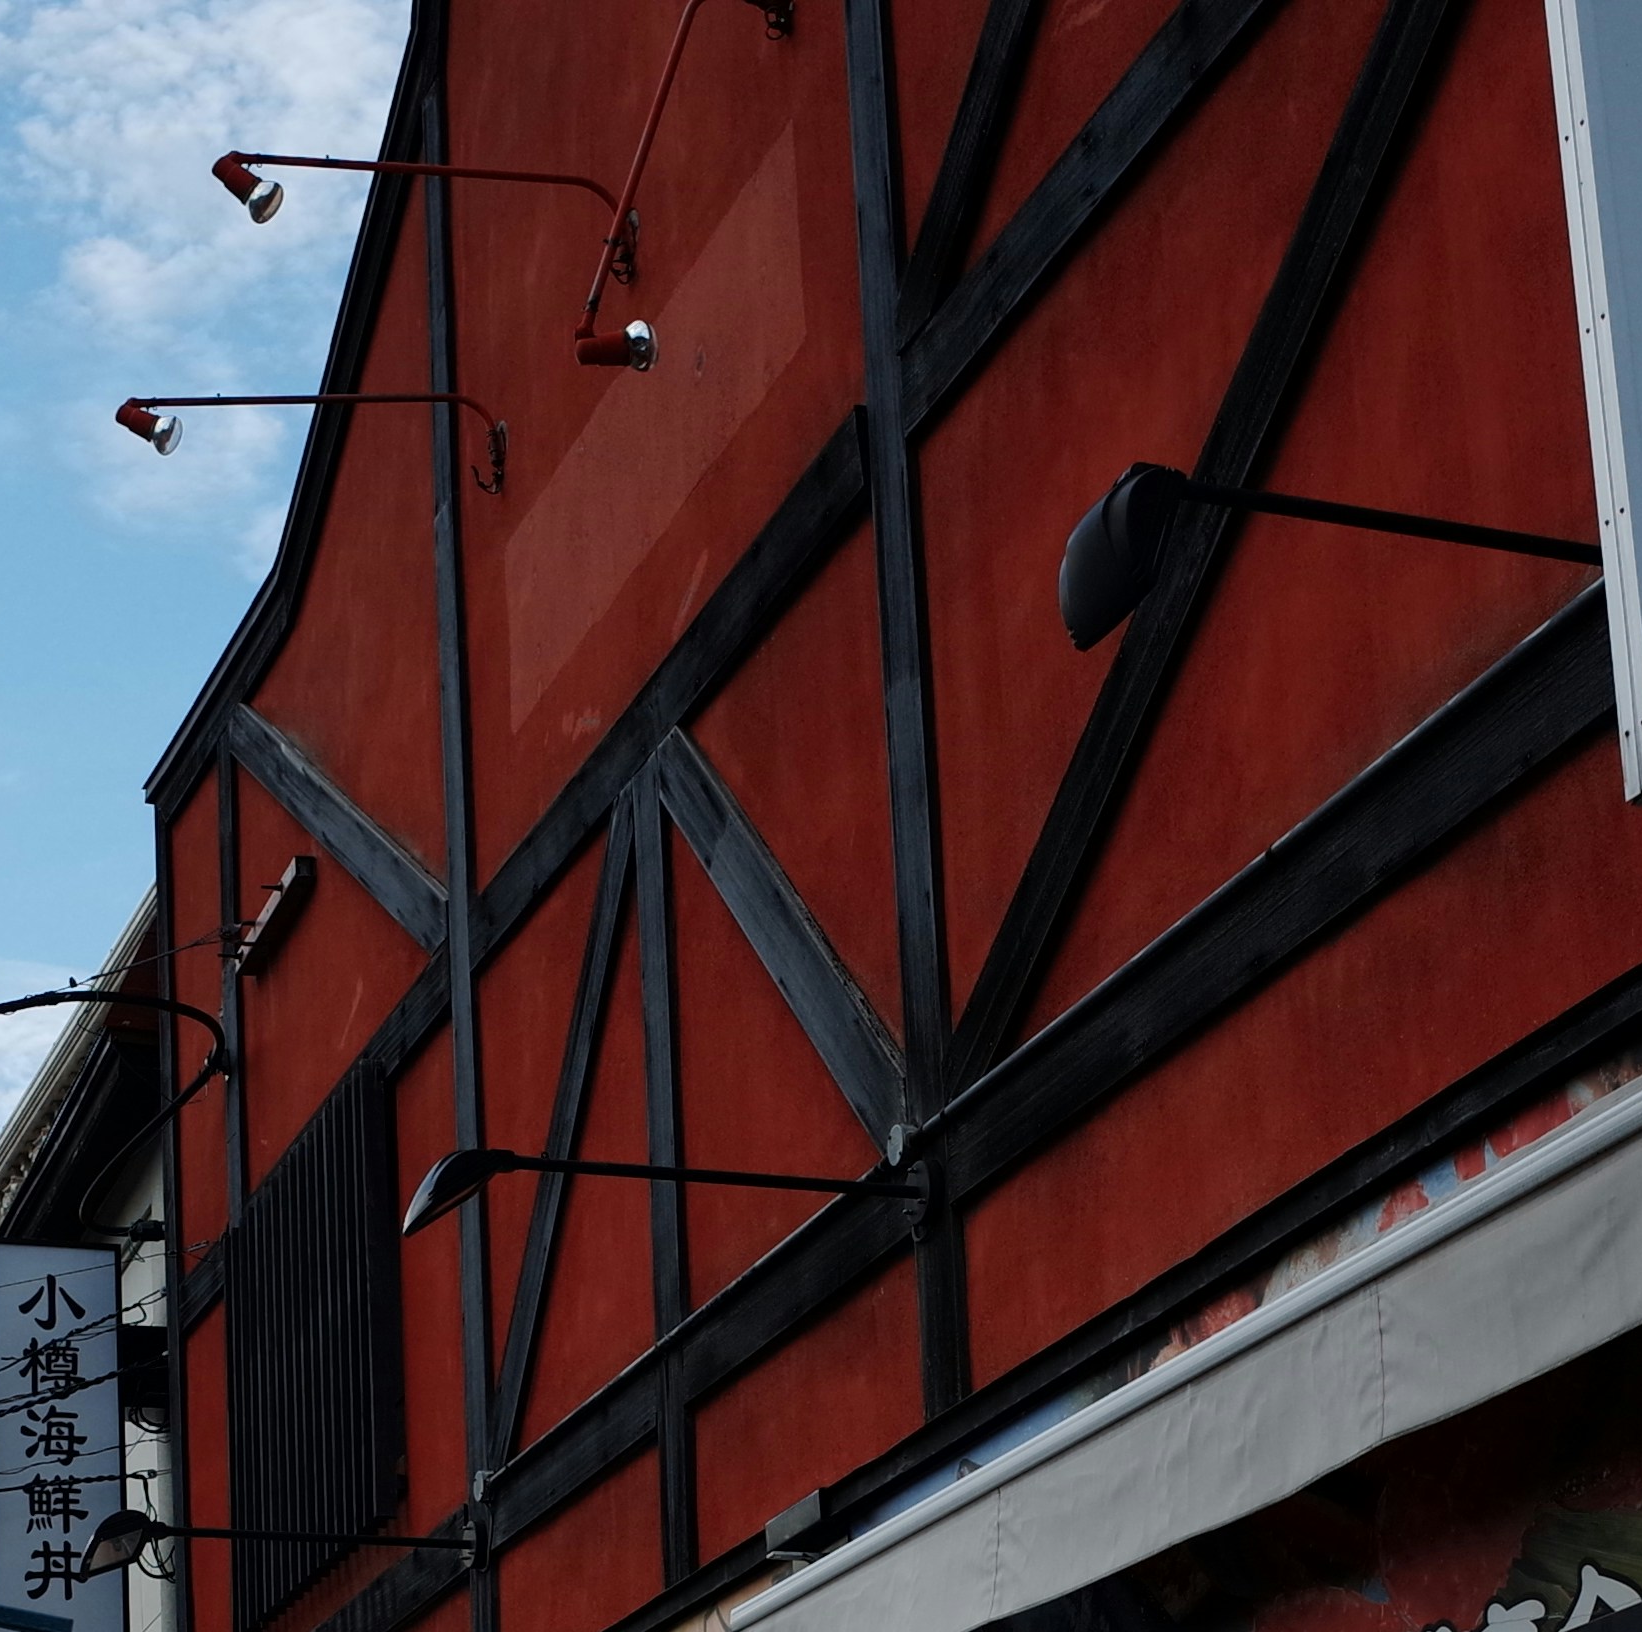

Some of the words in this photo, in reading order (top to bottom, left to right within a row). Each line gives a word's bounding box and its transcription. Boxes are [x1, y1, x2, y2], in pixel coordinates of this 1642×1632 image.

[18, 1273, 88, 1600] 小樽海鮮丼
